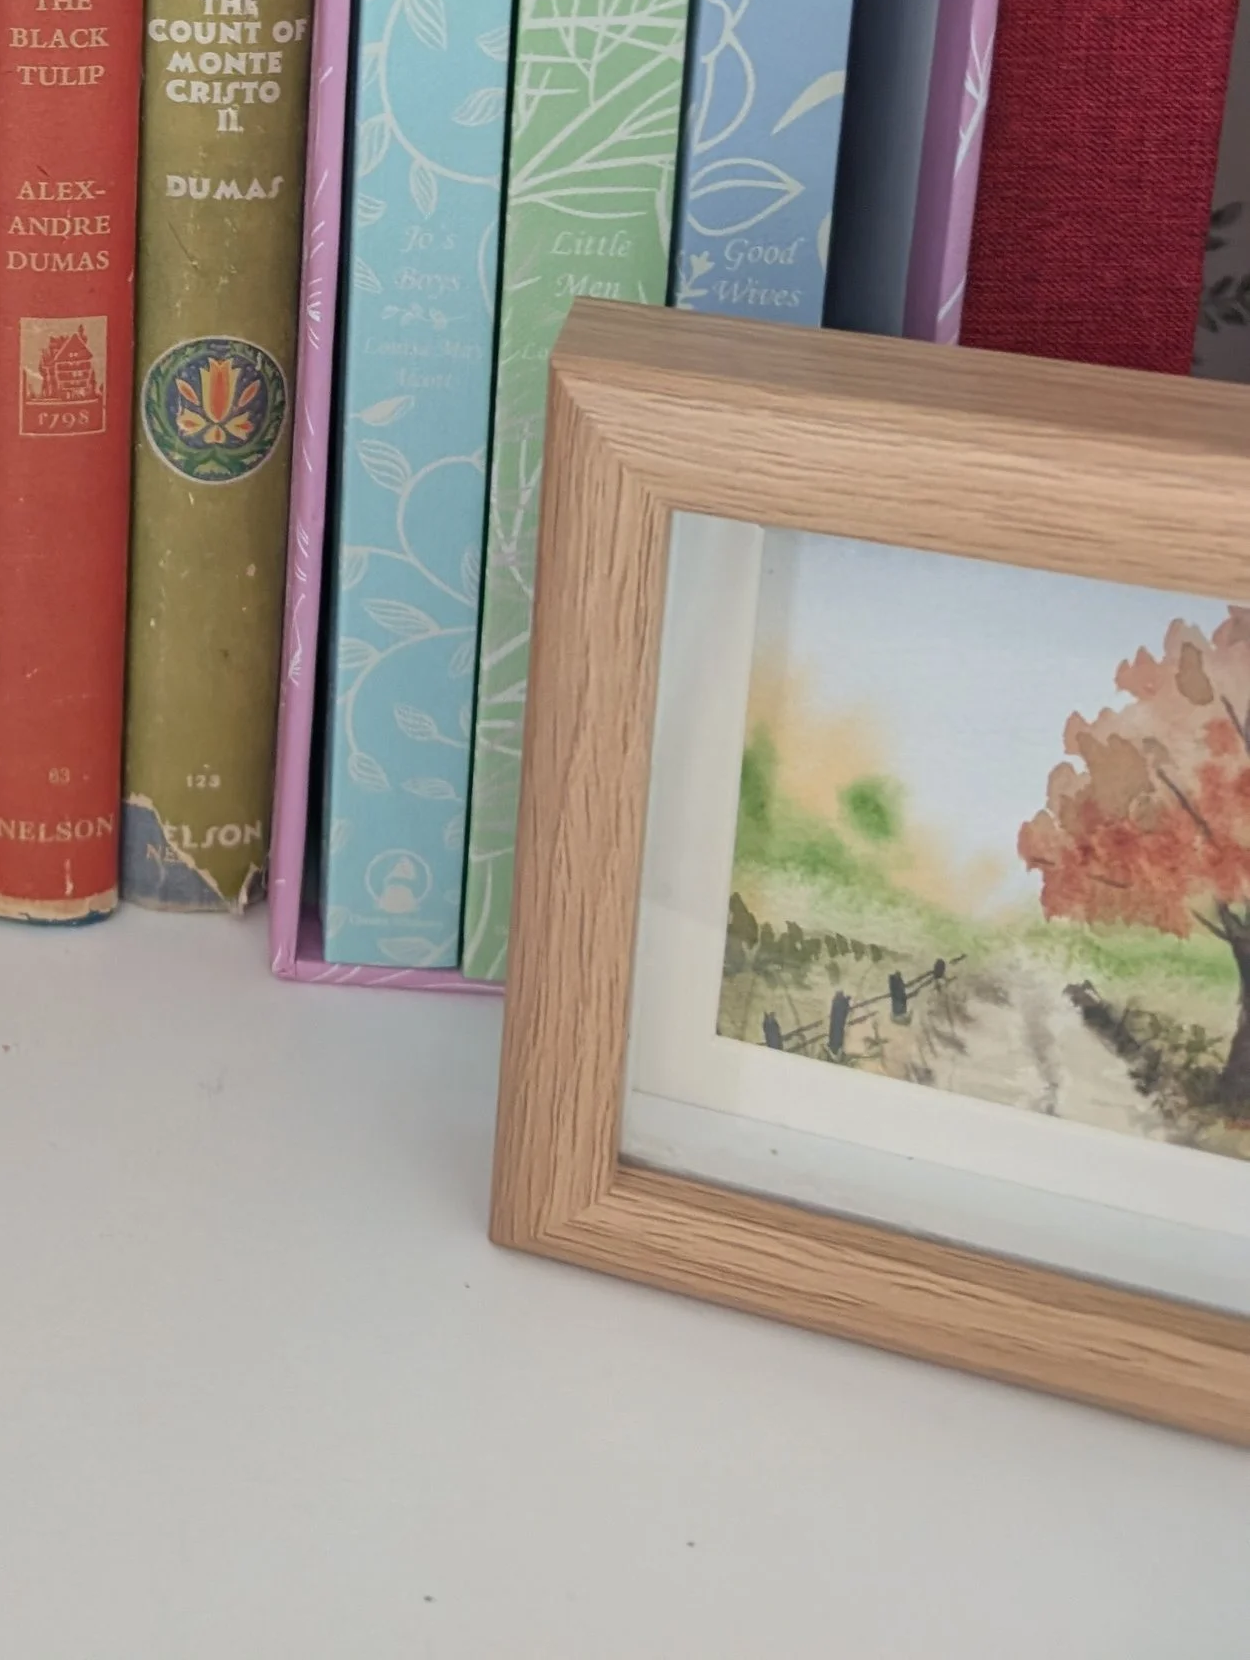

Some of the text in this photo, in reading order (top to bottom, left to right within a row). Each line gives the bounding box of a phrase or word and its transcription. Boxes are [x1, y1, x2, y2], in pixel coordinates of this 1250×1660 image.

[9, 27, 109, 48] BLACK
[148, 18, 308, 45] COUNT OF
[166, 50, 283, 75] MONTE
[16, 65, 105, 86] TULIP
[166, 79, 281, 104] CRISTO
[16, 181, 106, 201] ALEX-
[166, 175, 285, 200] DUMAS
[8, 215, 111, 237] ANDRE
[549, 229, 633, 258] Little
[724, 237, 806, 272] Good
[6, 249, 110, 272] DUMAS
[554, 272, 622, 299] Men
[711, 277, 802, 307] Wives
[37, 407, 91, 430] 1798
